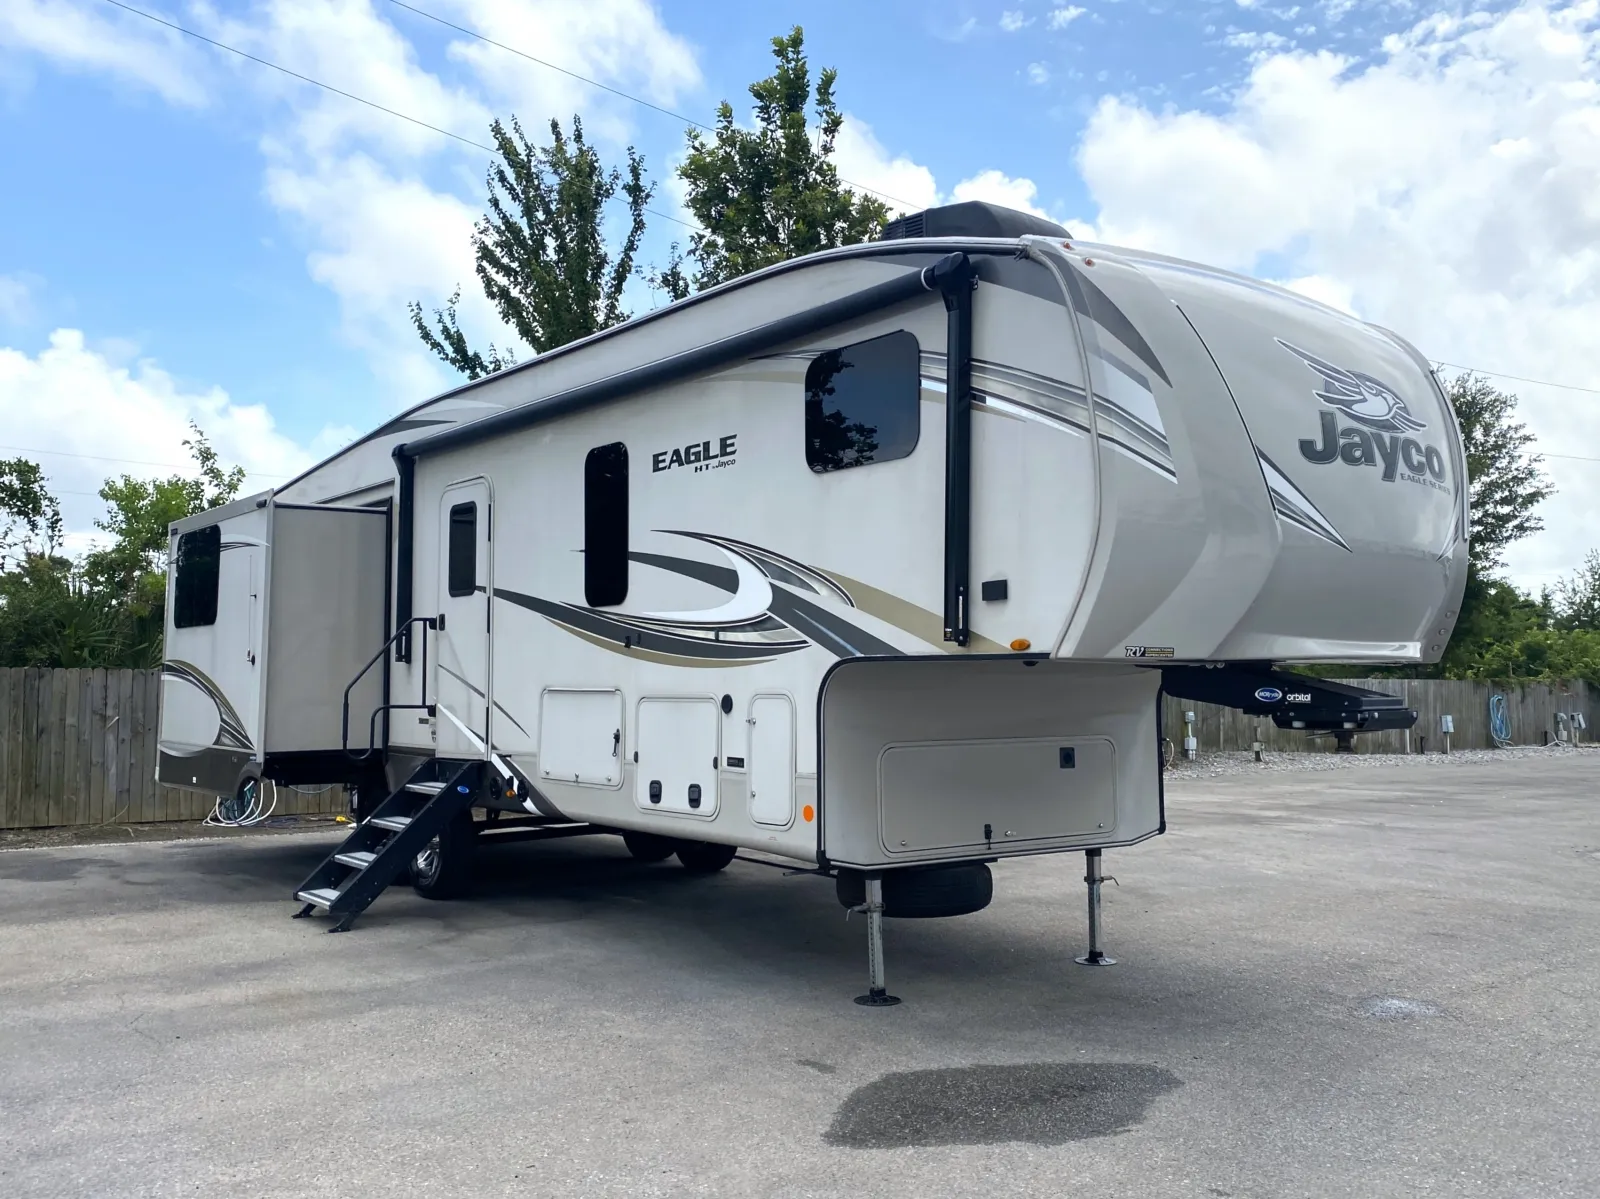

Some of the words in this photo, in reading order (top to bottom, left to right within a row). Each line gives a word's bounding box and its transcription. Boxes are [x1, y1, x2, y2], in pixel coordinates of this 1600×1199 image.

[652, 434, 738, 473] EAGLE
[1298, 410, 1447, 482] Jayco
[715, 459, 736, 469] Jayco
[1400, 472, 1428, 486] EAGLE
[1429, 480, 1451, 495] SERIES
[1125, 646, 1145, 657] RV
[1286, 693, 1311, 701] orbital
